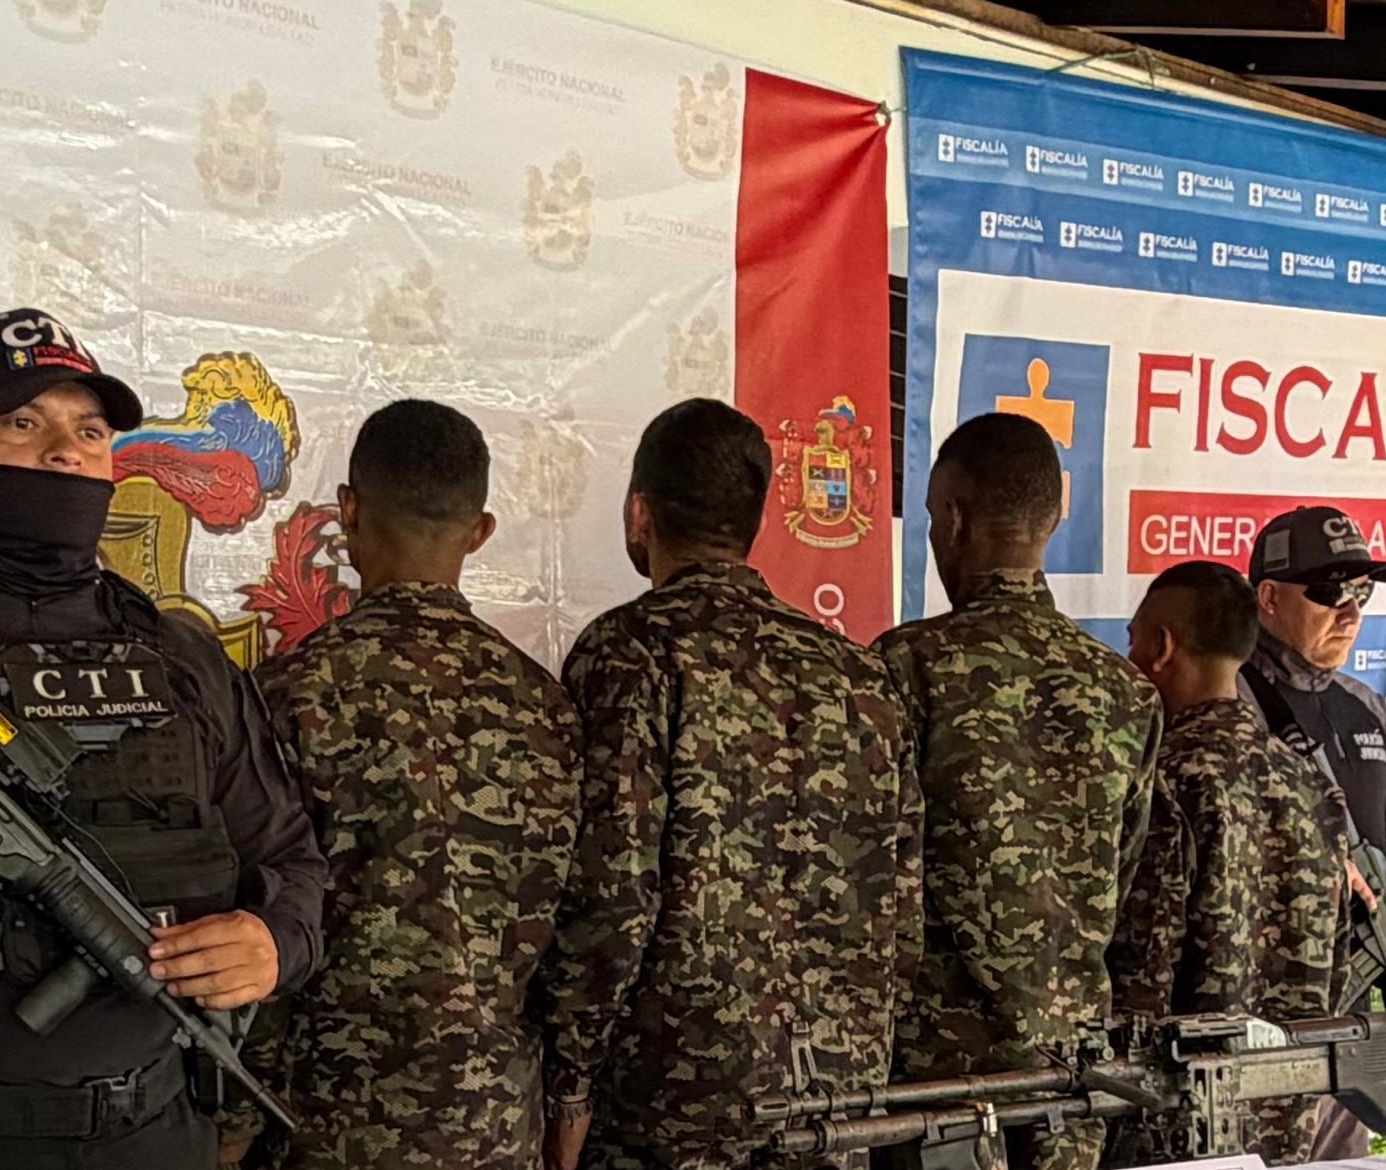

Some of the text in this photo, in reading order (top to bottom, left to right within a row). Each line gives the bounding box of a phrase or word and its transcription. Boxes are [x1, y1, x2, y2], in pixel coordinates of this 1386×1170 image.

[559, 73, 628, 103] NACIONAL
[24, 701, 168, 718] POLICIA JUDICIAL
